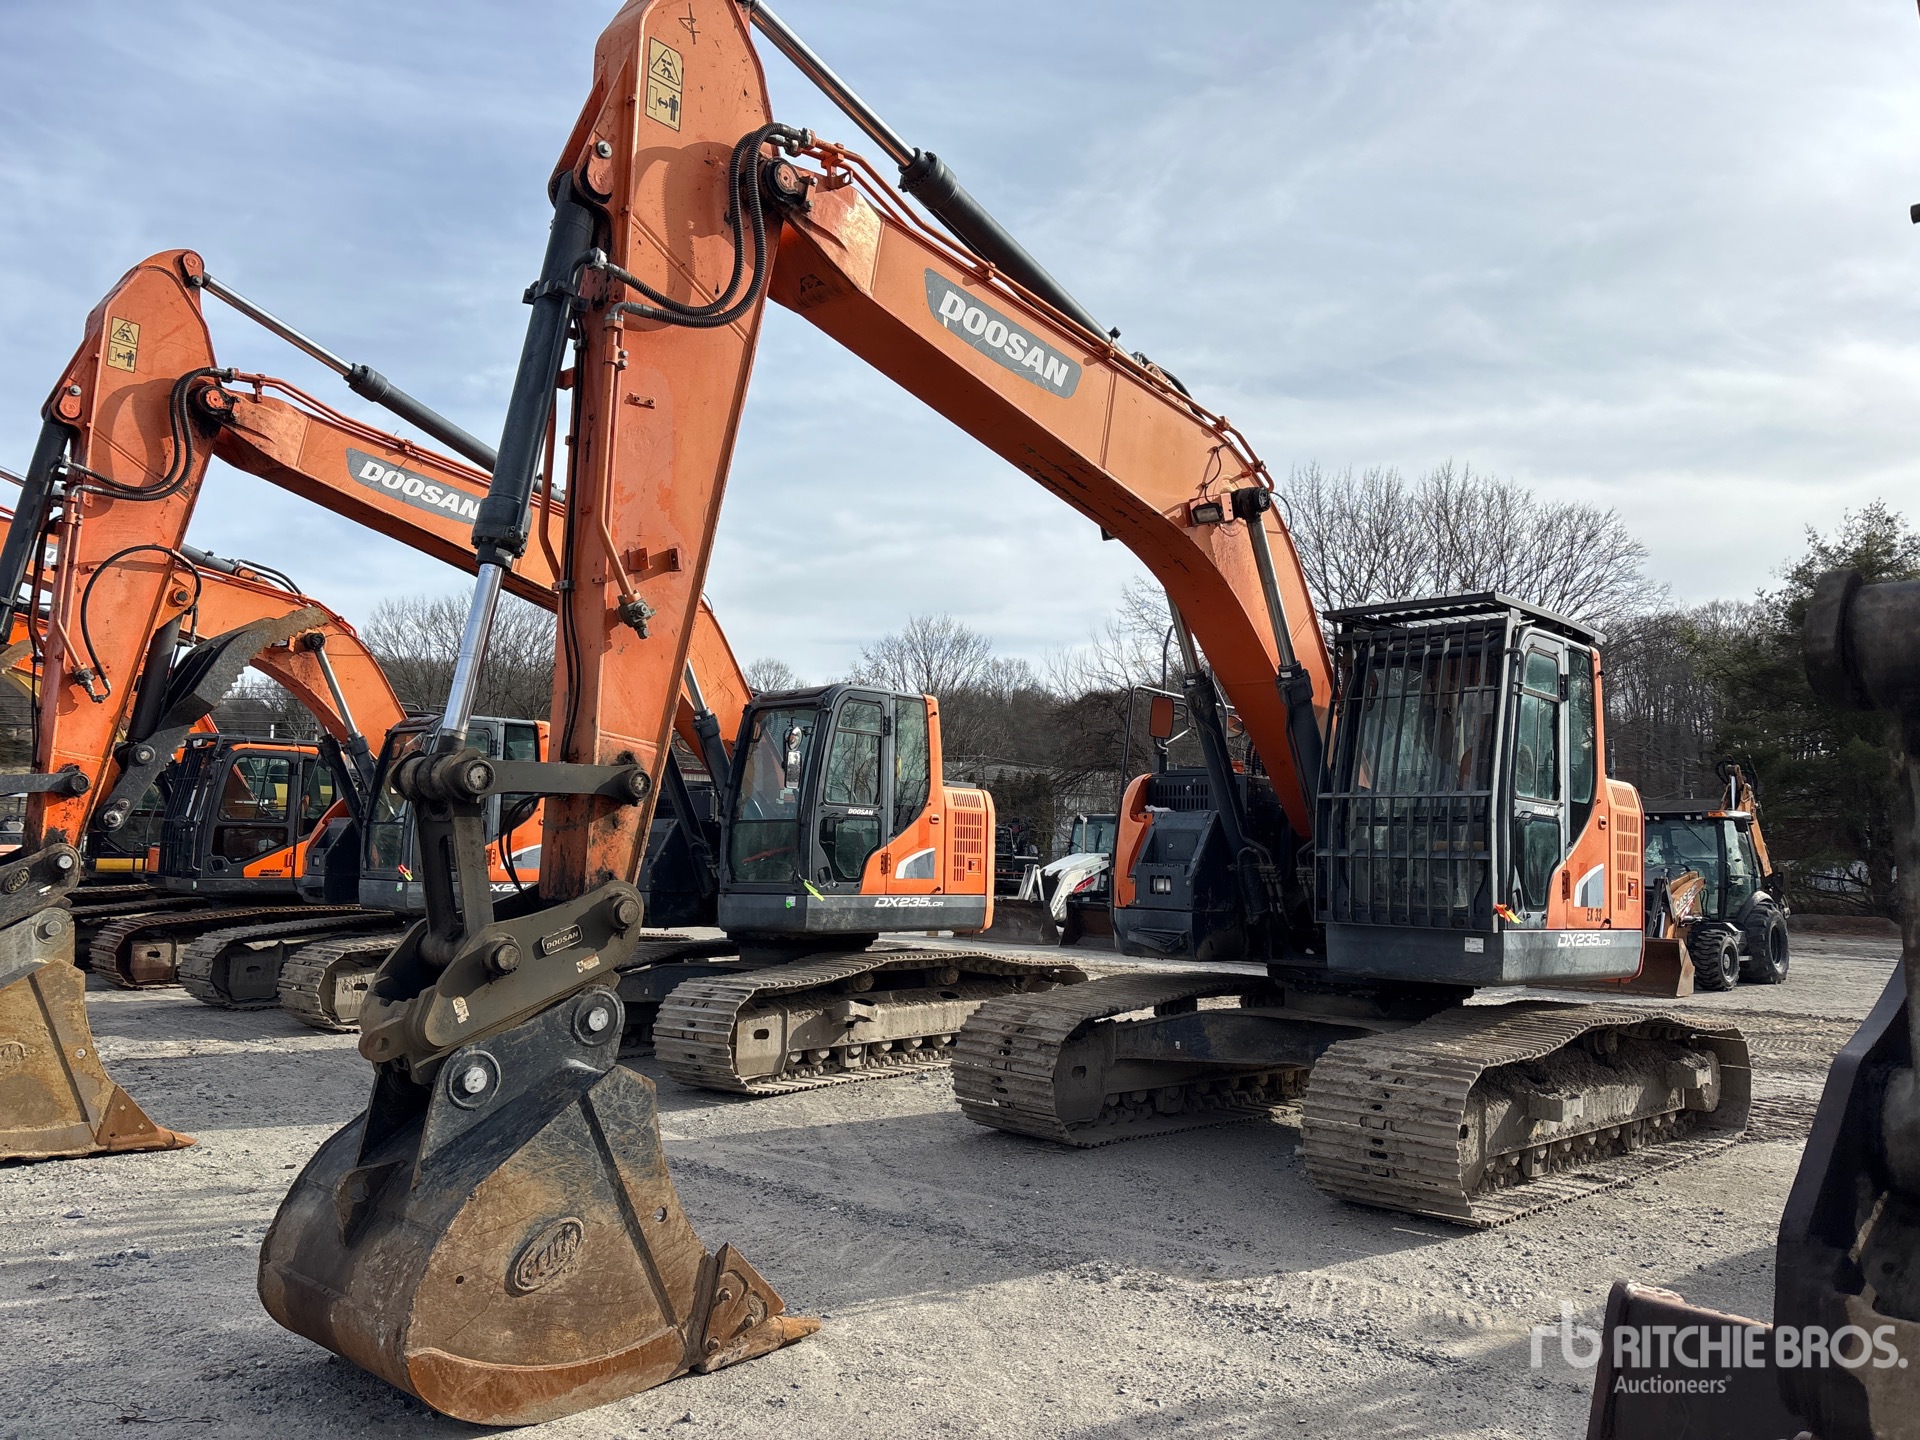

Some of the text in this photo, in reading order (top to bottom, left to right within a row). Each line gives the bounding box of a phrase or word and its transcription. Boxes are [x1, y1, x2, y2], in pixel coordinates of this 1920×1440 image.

[938, 289, 1069, 388] DOOSAN
[358, 460, 480, 520] DOOSAN
[848, 808, 874, 816] DOOSAN
[1534, 805, 1555, 816] DOOSAN
[1586, 907, 1594, 921] EX
[546, 931, 579, 950] DOOSAN
